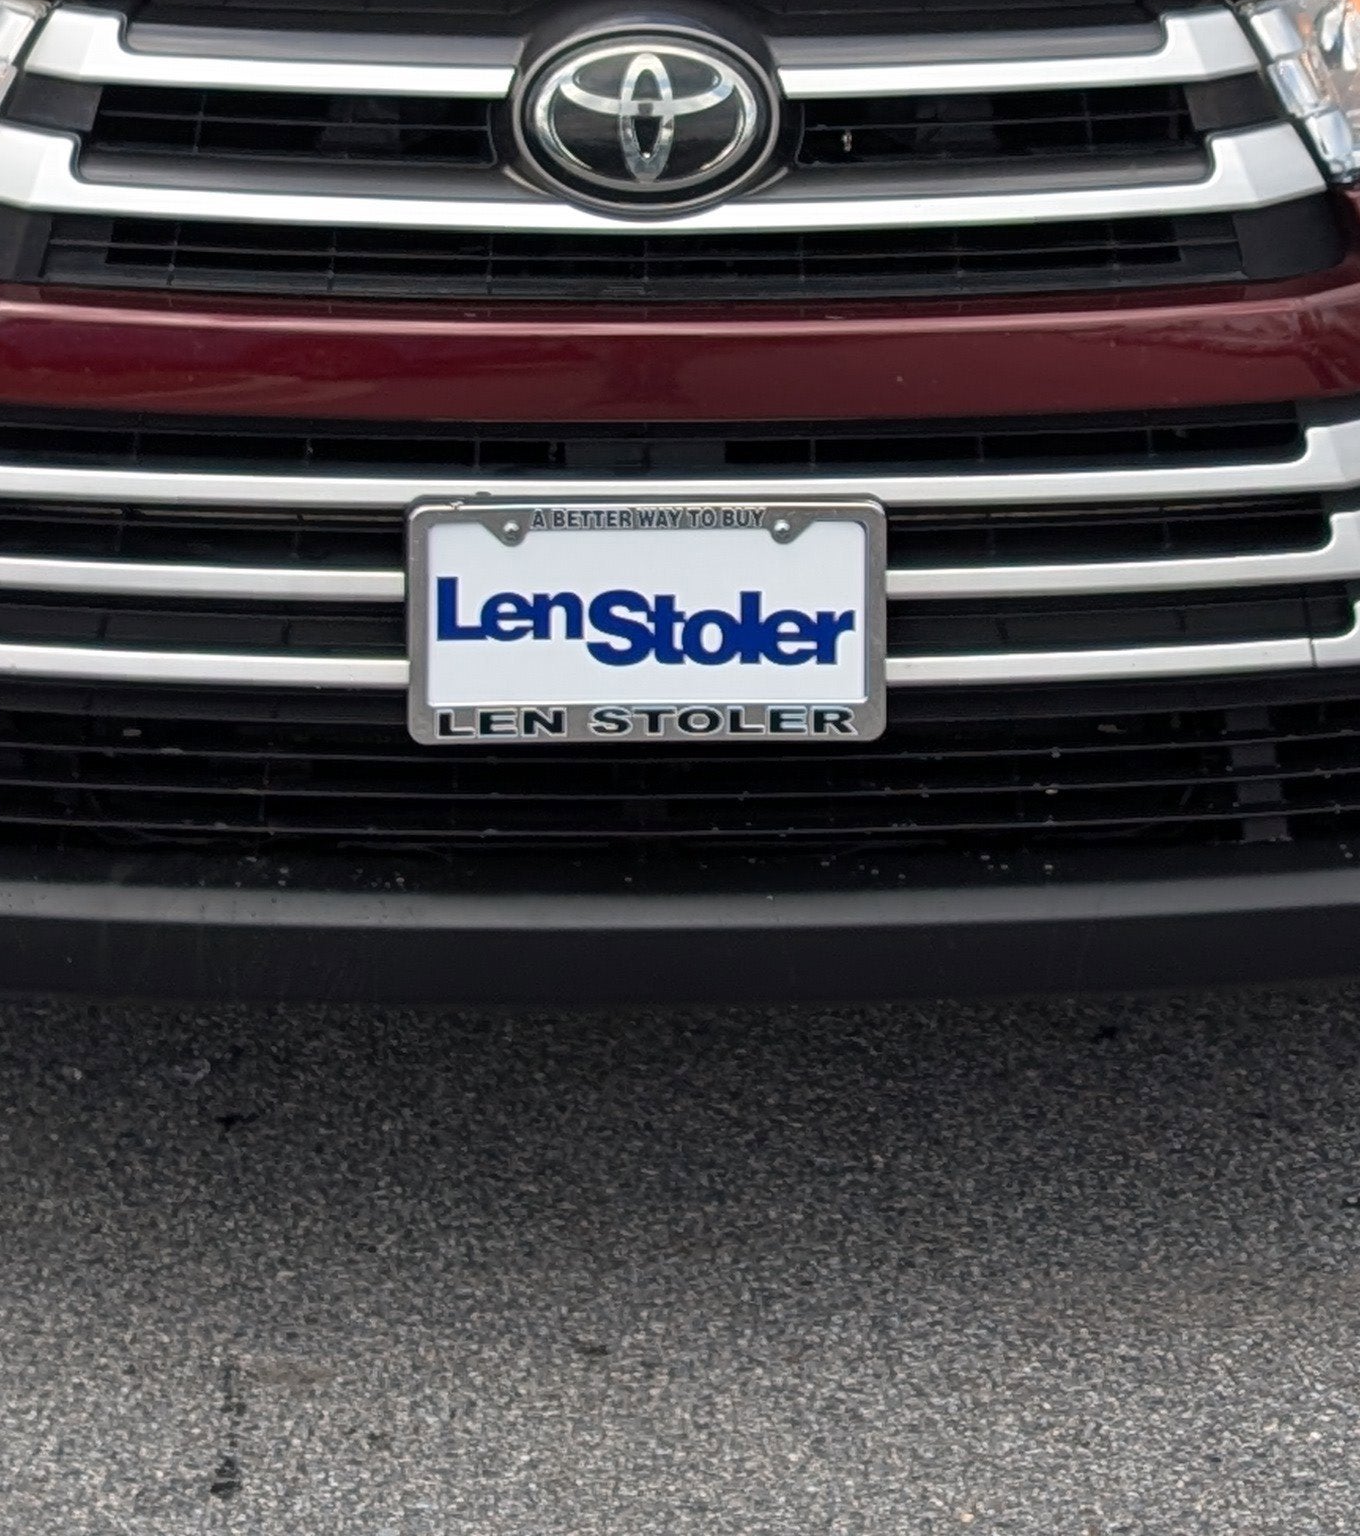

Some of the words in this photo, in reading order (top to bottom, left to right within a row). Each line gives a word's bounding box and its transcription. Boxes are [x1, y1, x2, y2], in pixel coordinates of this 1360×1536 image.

[531, 508, 547, 529] A
[551, 508, 632, 529] BETTER
[636, 508, 682, 528] WAY
[687, 508, 717, 528] TO
[720, 507, 766, 528] BUY
[436, 706, 568, 738] LEN
[588, 706, 859, 738] STOLER
